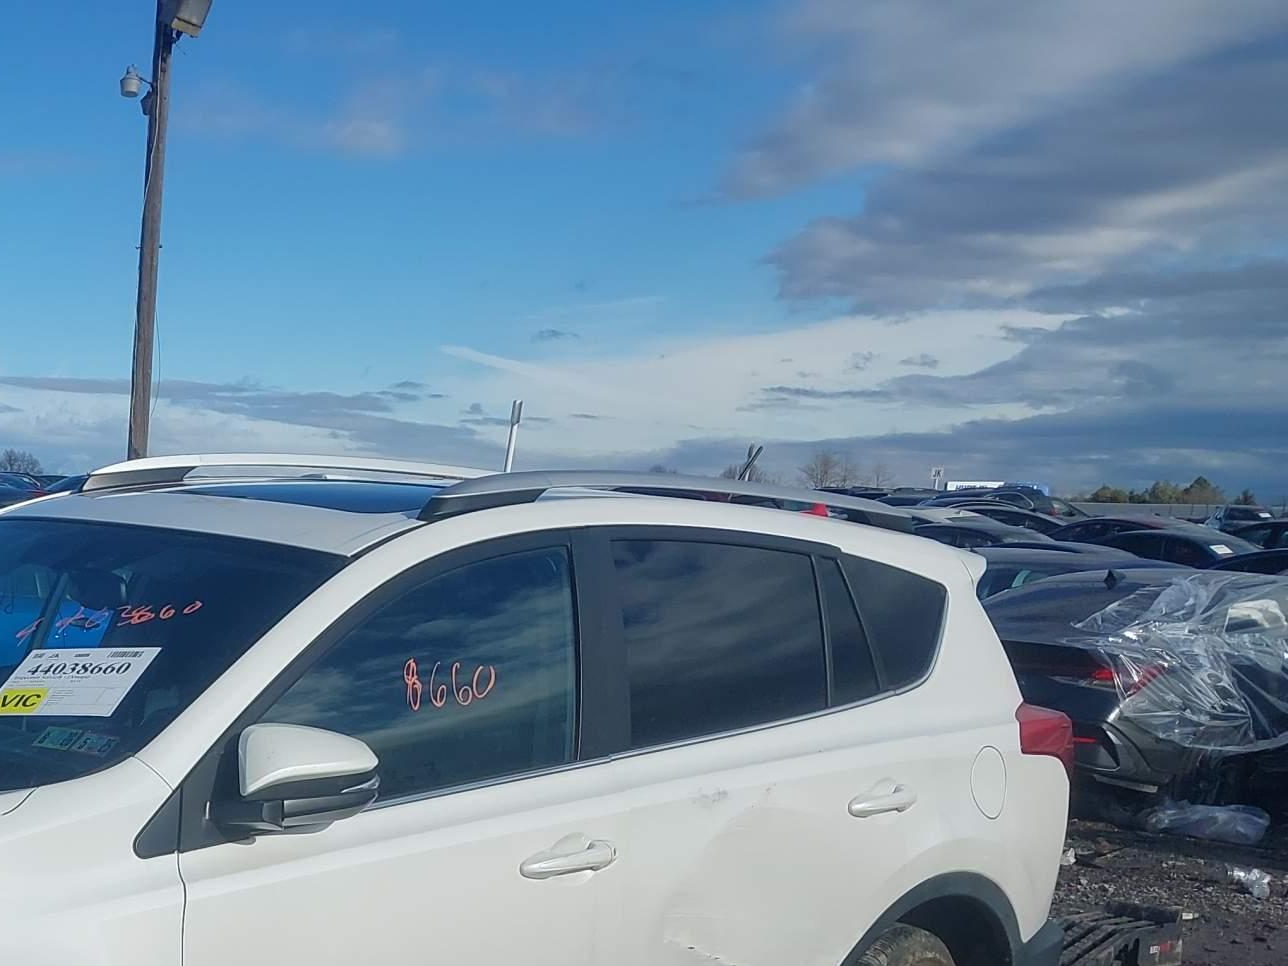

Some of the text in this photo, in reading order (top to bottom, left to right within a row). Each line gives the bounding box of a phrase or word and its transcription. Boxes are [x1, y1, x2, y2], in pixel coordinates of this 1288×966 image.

[27, 662, 132, 676] 44038660
[403, 658, 496, 711] 8660
[0, 693, 42, 708] VIC
